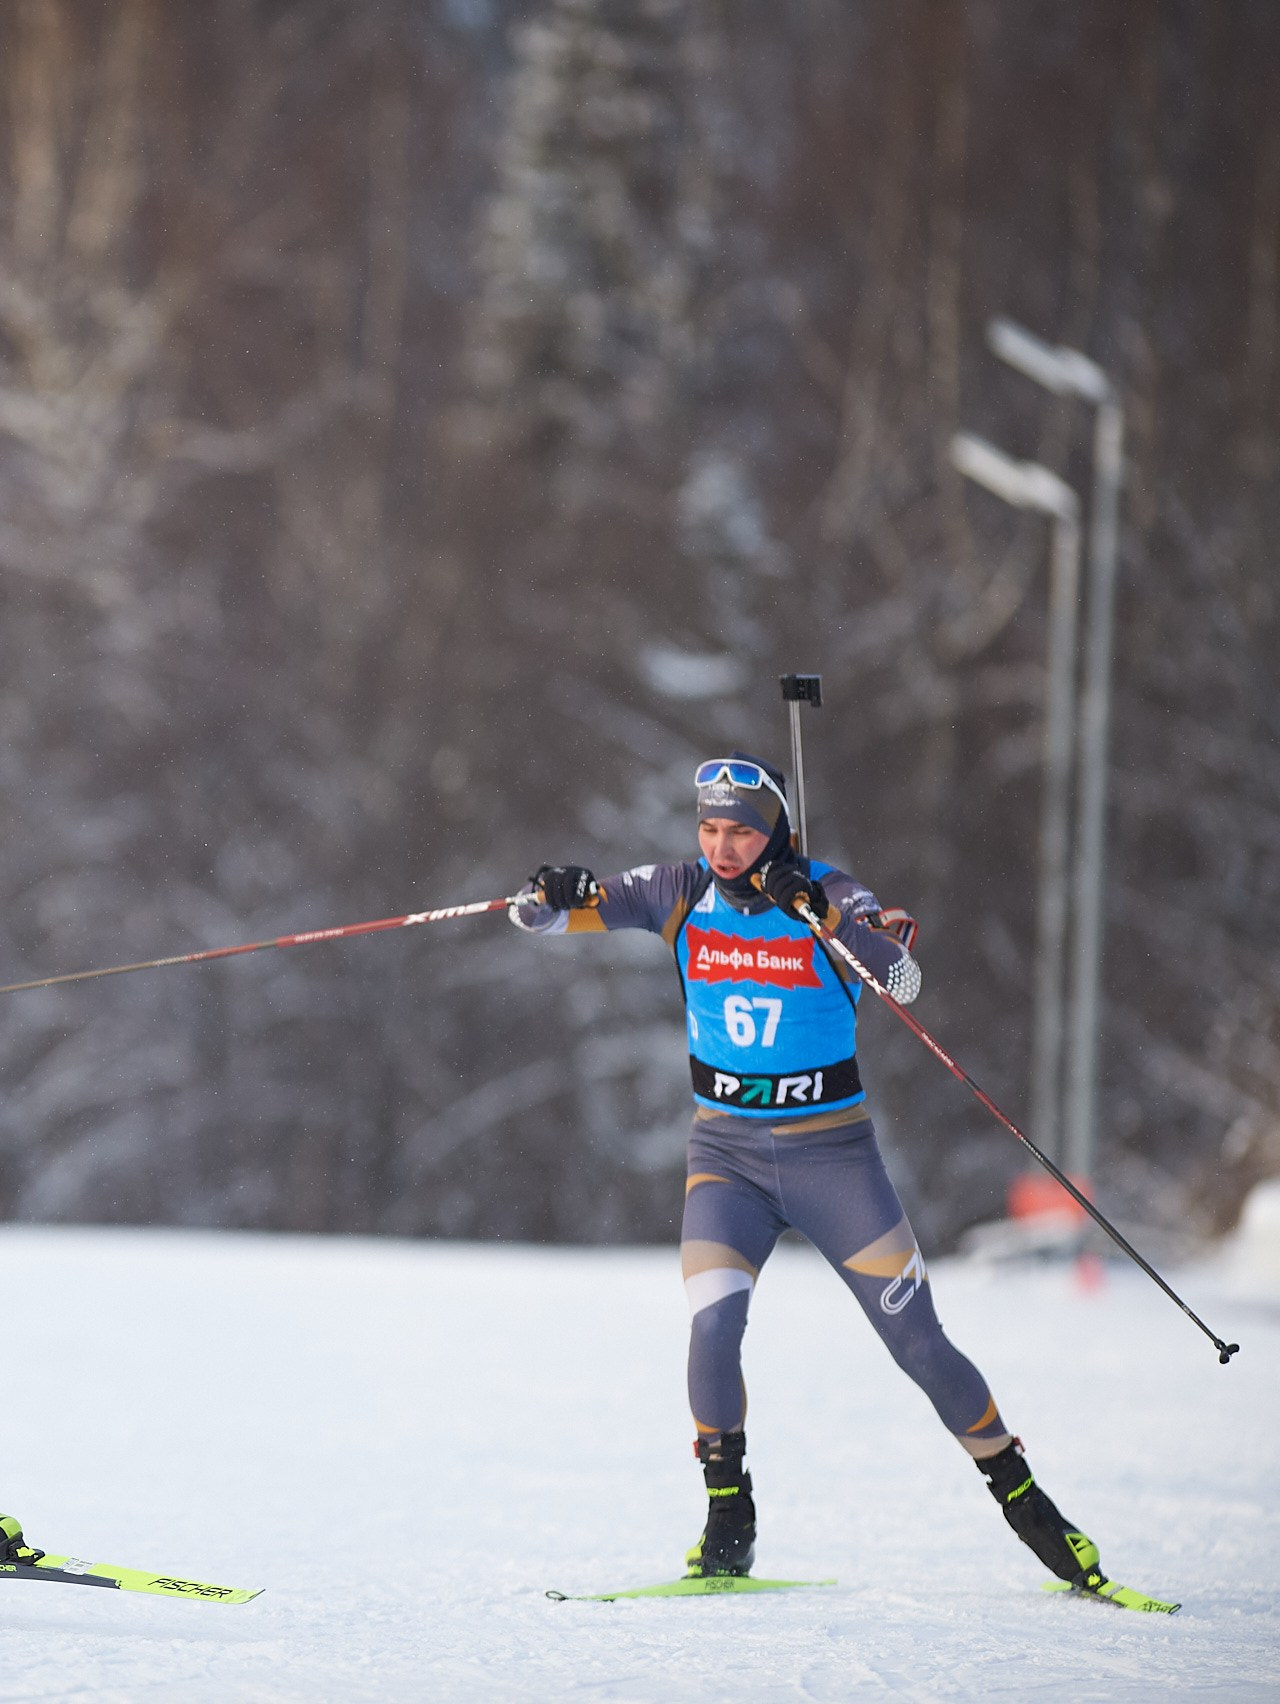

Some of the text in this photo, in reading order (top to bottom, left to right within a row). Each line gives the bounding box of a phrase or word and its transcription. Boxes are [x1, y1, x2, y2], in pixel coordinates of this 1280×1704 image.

[697, 945, 804, 971] Альфа Банк
[723, 994, 783, 1047] 67
[714, 1071, 823, 1105] PARI
[147, 1577, 233, 1599] FISCHER
